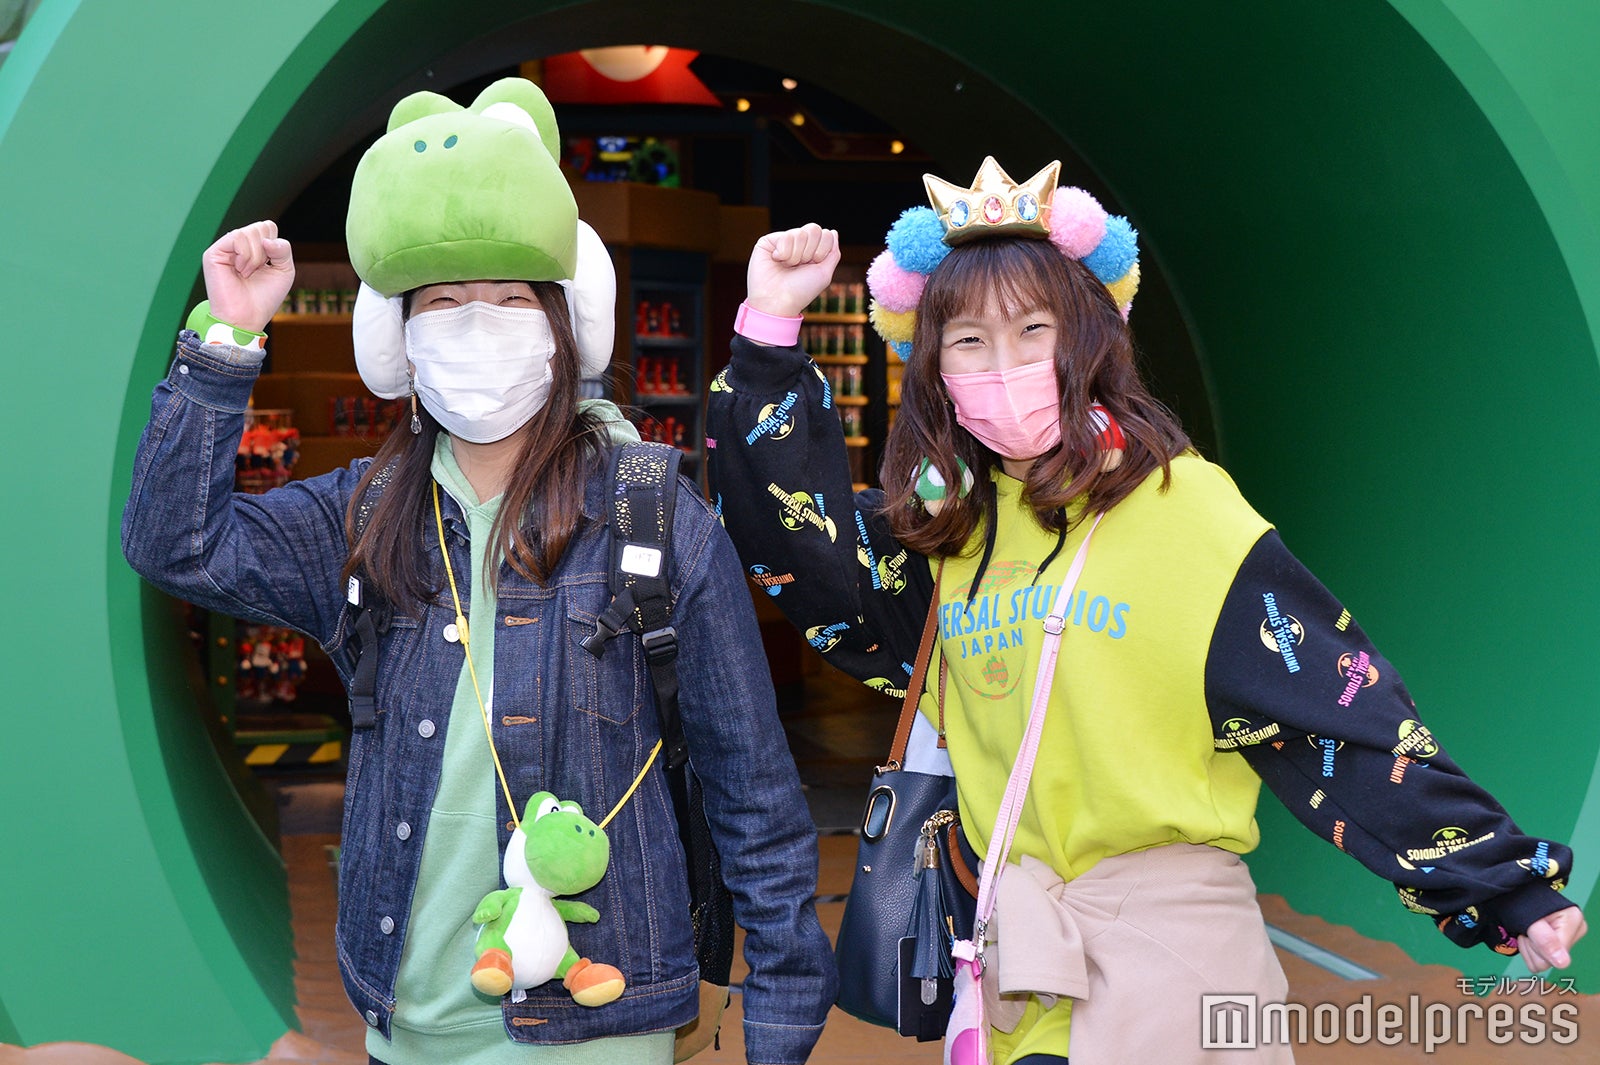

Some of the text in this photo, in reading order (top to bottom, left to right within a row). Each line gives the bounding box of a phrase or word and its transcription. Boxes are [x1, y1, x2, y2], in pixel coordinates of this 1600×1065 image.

[745, 391, 799, 446] UNIVERSAL STUOS
[767, 482, 804, 515] UNIVERSAL
[783, 506, 806, 524] JAPAN
[888, 548, 908, 571] STUDI
[960, 627, 1024, 660] JAPAN
[1262, 592, 1301, 675] UNIVERSAL STUDIOS
[1281, 617, 1297, 644] JAPAN
[884, 687, 907, 699] STUDI
[1337, 673, 1364, 708] STUDIOS
[1236, 722, 1281, 747] UNIVERSAL
[1322, 738, 1336, 778] STUDIOS
[1406, 846, 1448, 861] STUDIOS
[1436, 837, 1467, 848] JAPAN
